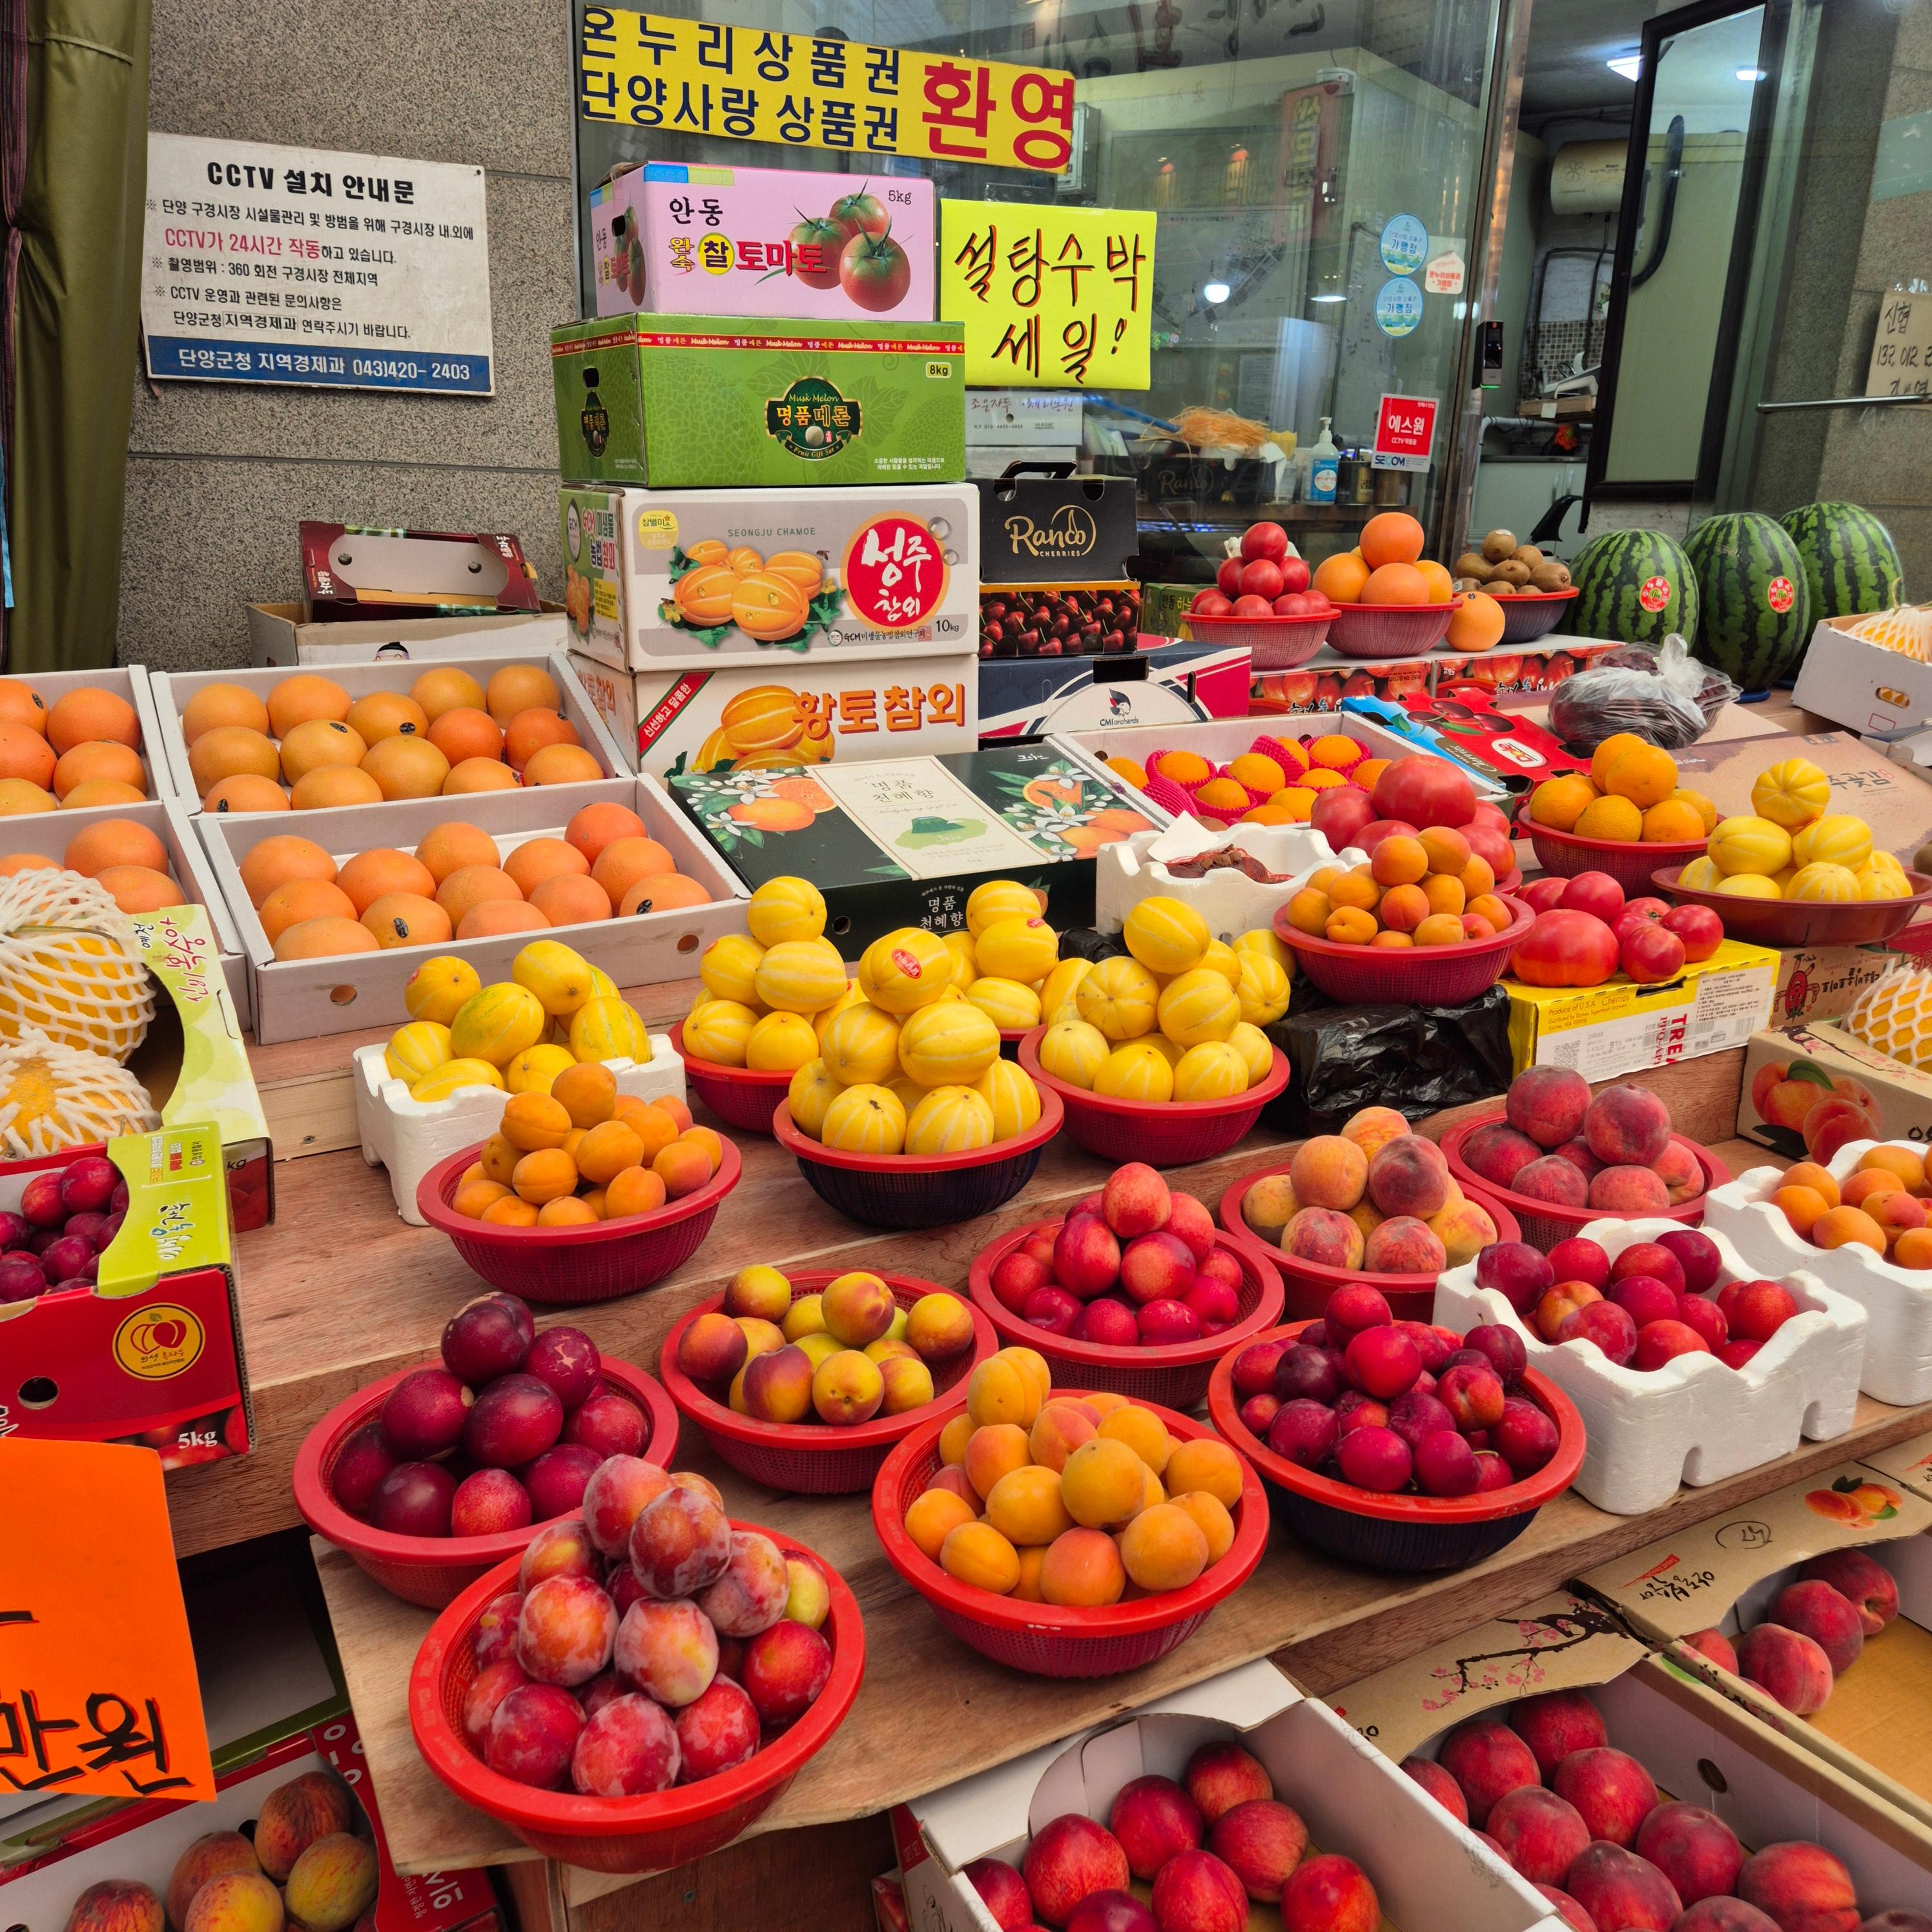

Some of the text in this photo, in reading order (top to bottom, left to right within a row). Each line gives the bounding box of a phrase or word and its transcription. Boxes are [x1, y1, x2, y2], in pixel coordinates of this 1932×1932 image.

[582, 70, 898, 152] 단양사랑 상품권
[922, 61, 1074, 169] 환영
[207, 161, 415, 205] CCTV 설치 안내문
[889, 190, 912, 206] 5kg
[162, 200, 187, 216] 단양
[191, 201, 241, 220] 구경시장
[245, 205, 305, 226] 시설물관리
[309, 212, 320, 227] 및
[325, 212, 360, 231] 방범을
[364, 216, 386, 233] 위해
[390, 218, 435, 238] 구경시장
[669, 197, 724, 227] 안동
[165, 228, 397, 264] CCTV가 24시간 작동하고 있습니다.
[669, 236, 695, 272] 완숙
[1391, 239, 1417, 254] 가맹점
[229, 262, 249, 277] 360
[254, 264, 278, 279] 회전
[282, 265, 329, 284] 구경시장
[333, 269, 378, 286] 전체지역
[170, 285, 343, 311] CCTV 운영과 관련된 문의사항은
[1387, 303, 1413, 314] 가맹점
[173, 310, 411, 339] 단양군청 지역경제과 연락주시기 바랍니다.
[991, 313, 1127, 384] 세일!
[1876, 344, 1896, 367] 132
[178, 349, 252, 371] 단양군청
[258, 351, 345, 376] 지역경제과
[929, 364, 949, 376] 8kg
[788, 393, 839, 403] Musk Melon
[776, 404, 852, 427] 명품메론
[1388, 415, 1425, 436] 에스원
[811, 449, 824, 458] Gift
[825, 447, 836, 457] Set
[1391, 437, 1405, 445] CCTV
[1374, 455, 1406, 466] SECOM
[727, 526, 817, 538] SEONGJU CHAMOE
[1004, 508, 1087, 557] Ranco
[860, 527, 933, 594] 성주
[1039, 550, 1081, 558] CHERRIES
[873, 588, 921, 622] 참외
[935, 619, 960, 633] 10kg
[1443, 666, 1456, 676] 5kg
[643, 682, 692, 738] 신선하고 달콤한
[792, 682, 966, 742] 황토참외
[1450, 744, 1498, 773] Cherries
[1500, 743, 1533, 763] Dole
[872, 779, 914, 792] 명품
[872, 788, 936, 803] 천혜향
[937, 834, 961, 843] Jeju
[928, 895, 956, 914] 명품
[920, 911, 964, 931] 천혜향
[159, 916, 209, 1002] 신비복숭아
[1548, 1005, 1571, 1016] Produce
[1572, 1003, 1579, 1011] of
[1601, 993, 1630, 1007] Cherries
[140, 1353, 159, 1364] 의성
[178, 1430, 218, 1450] 5kg
